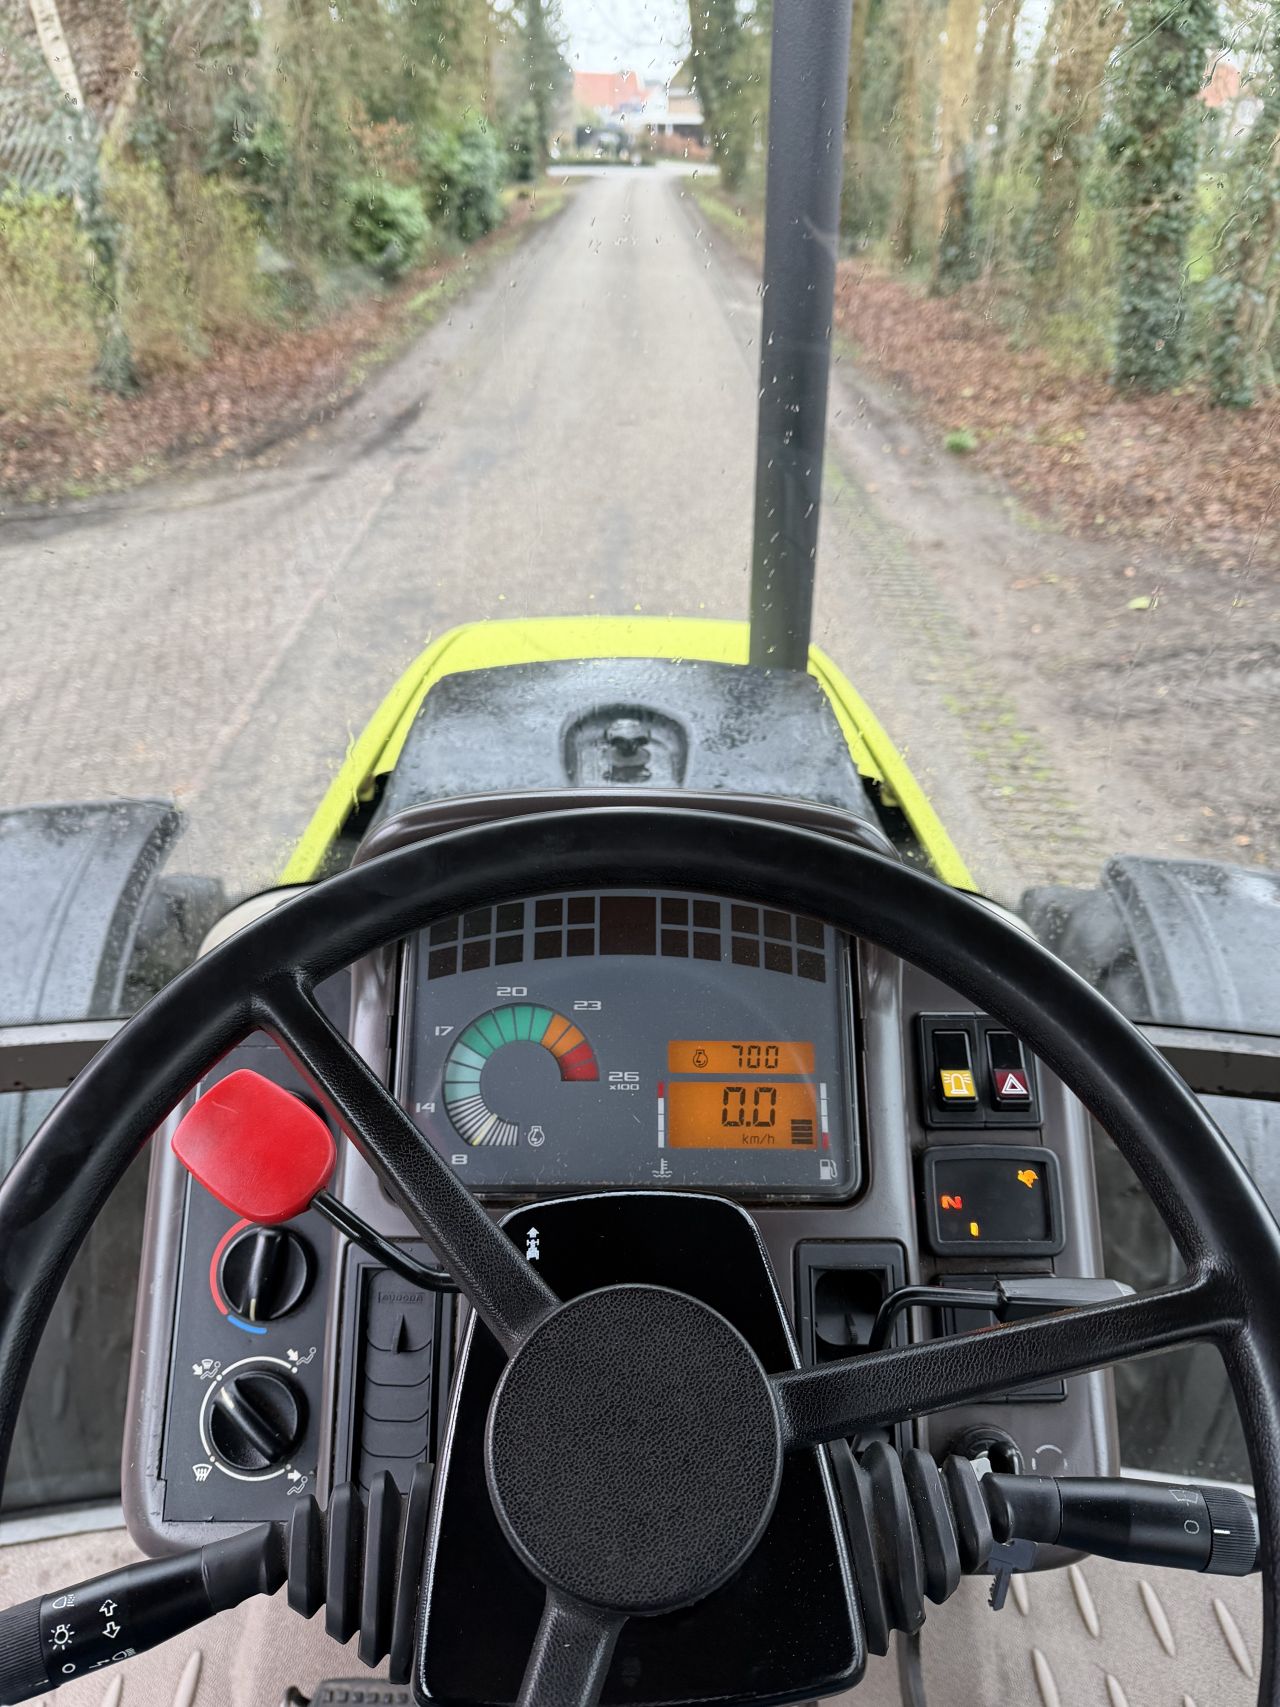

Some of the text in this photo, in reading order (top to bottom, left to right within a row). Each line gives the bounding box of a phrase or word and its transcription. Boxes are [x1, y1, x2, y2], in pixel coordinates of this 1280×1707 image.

[497, 986, 528, 997] 20
[573, 1001, 602, 1011] 23
[435, 1026, 454, 1037] 17
[731, 1045, 779, 1069] 700
[608, 1071, 640, 1082] 26
[609, 1083, 640, 1091] x100
[415, 1102, 436, 1113] 14
[742, 1133, 775, 1145] km/h
[451, 1154, 468, 1165] 8
